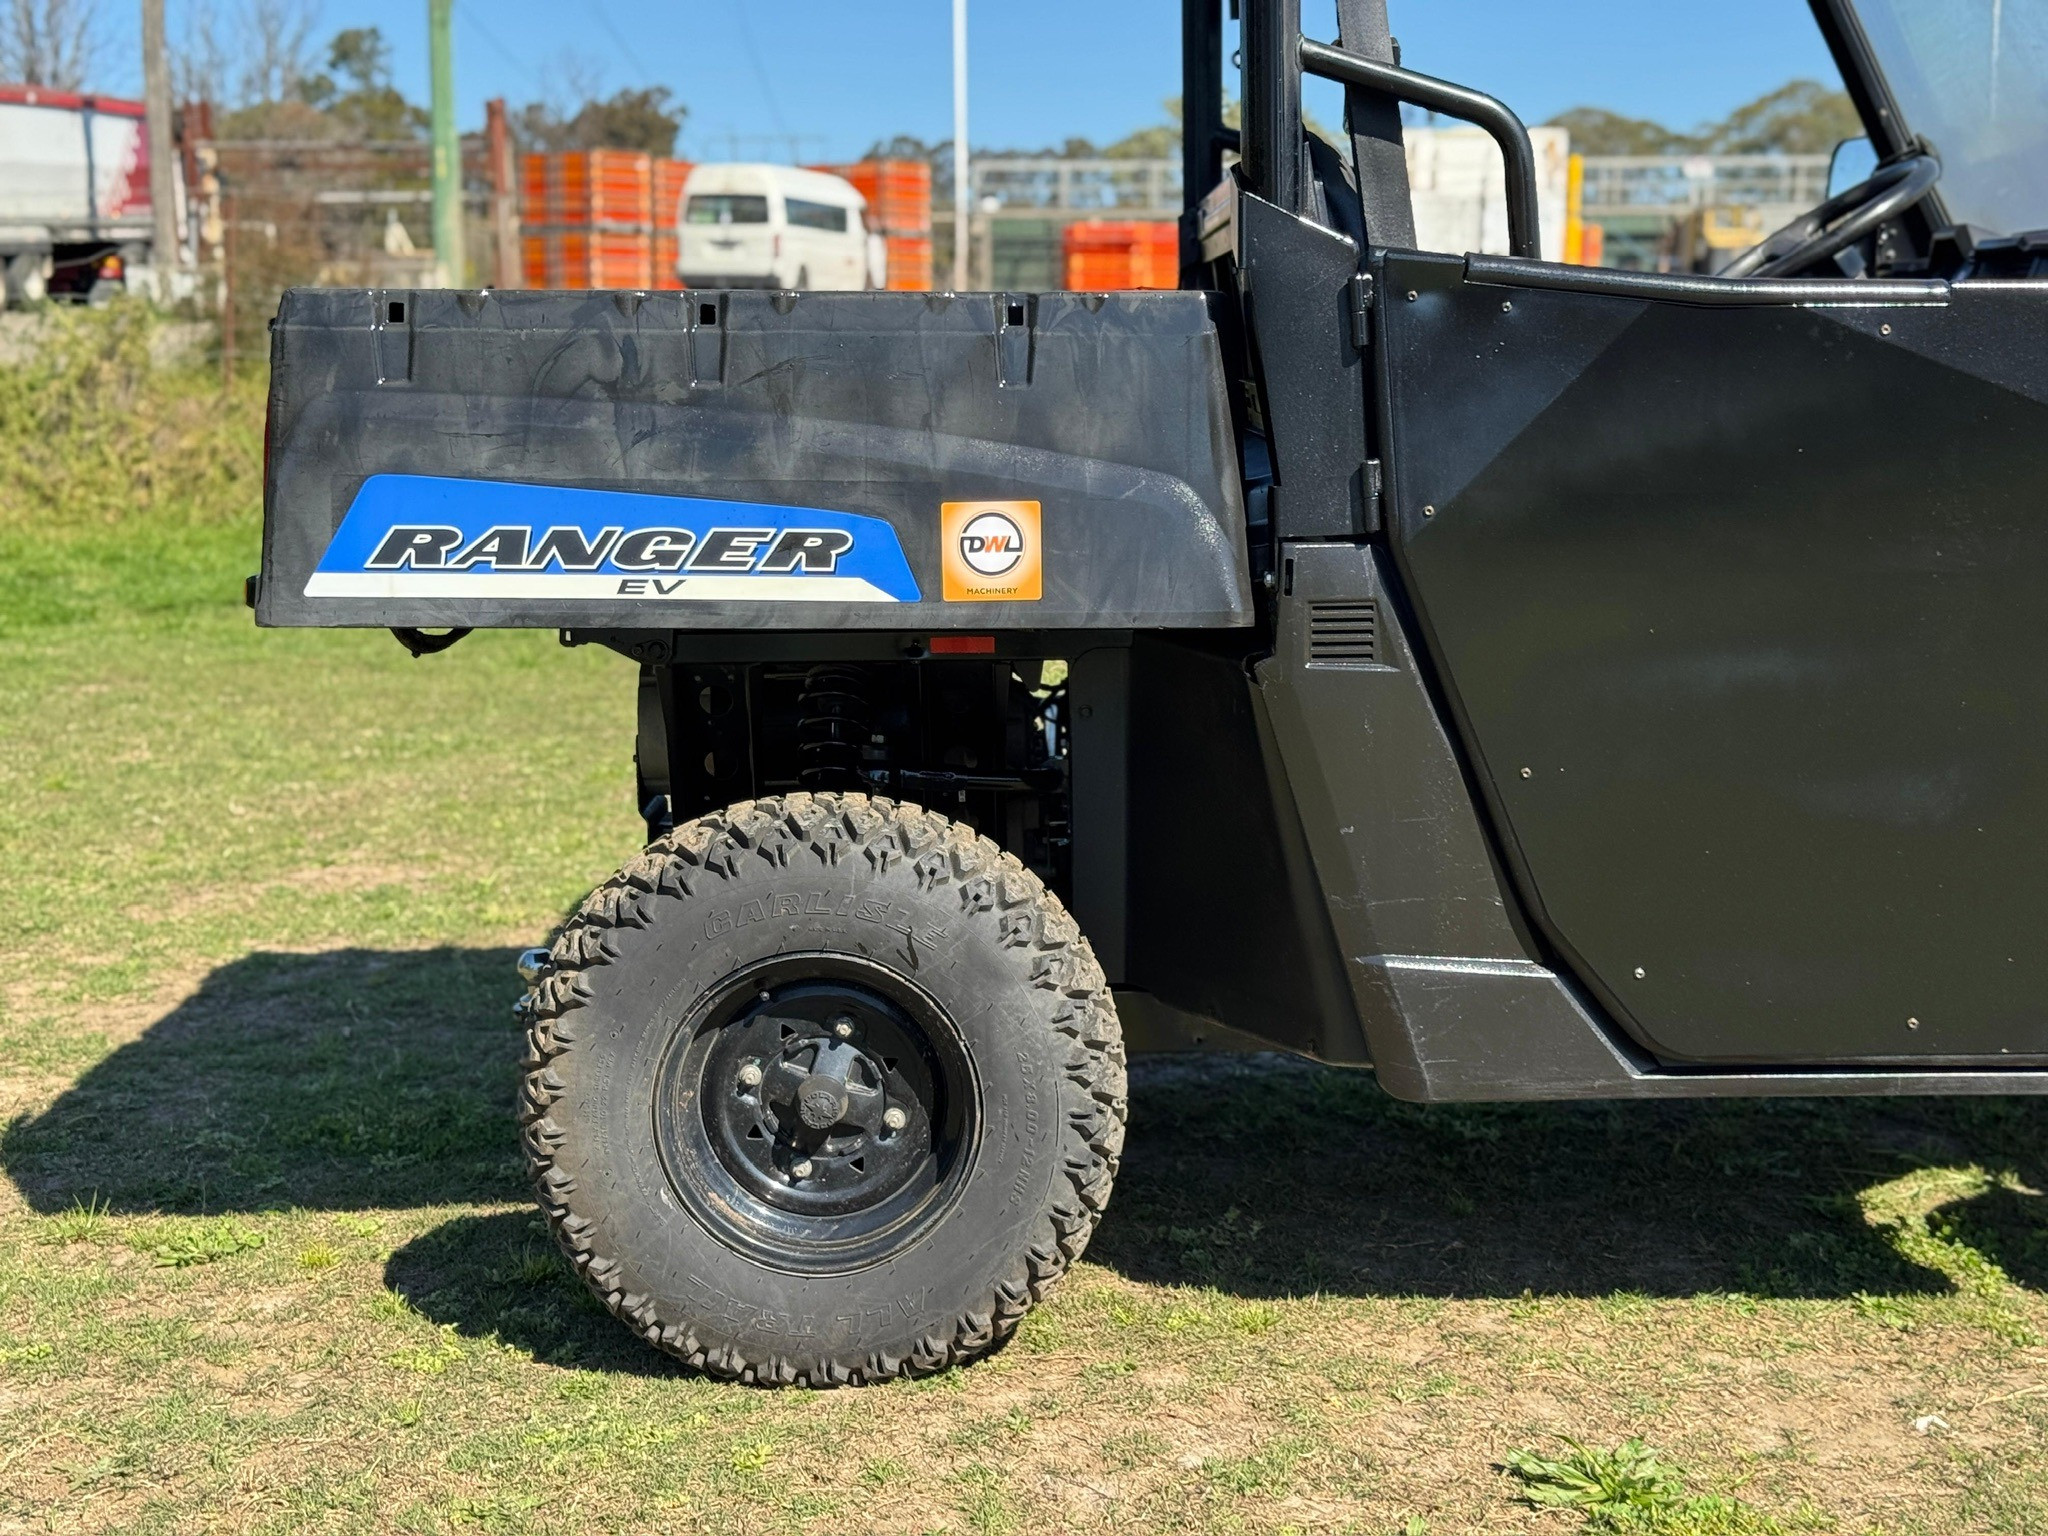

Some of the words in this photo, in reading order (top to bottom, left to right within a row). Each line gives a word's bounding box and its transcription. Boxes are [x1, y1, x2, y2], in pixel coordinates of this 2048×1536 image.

[364, 525, 854, 573] RANGER
[961, 535, 1022, 553] DWL
[616, 579, 687, 595] EV
[966, 587, 1018, 595] MACHINERY
